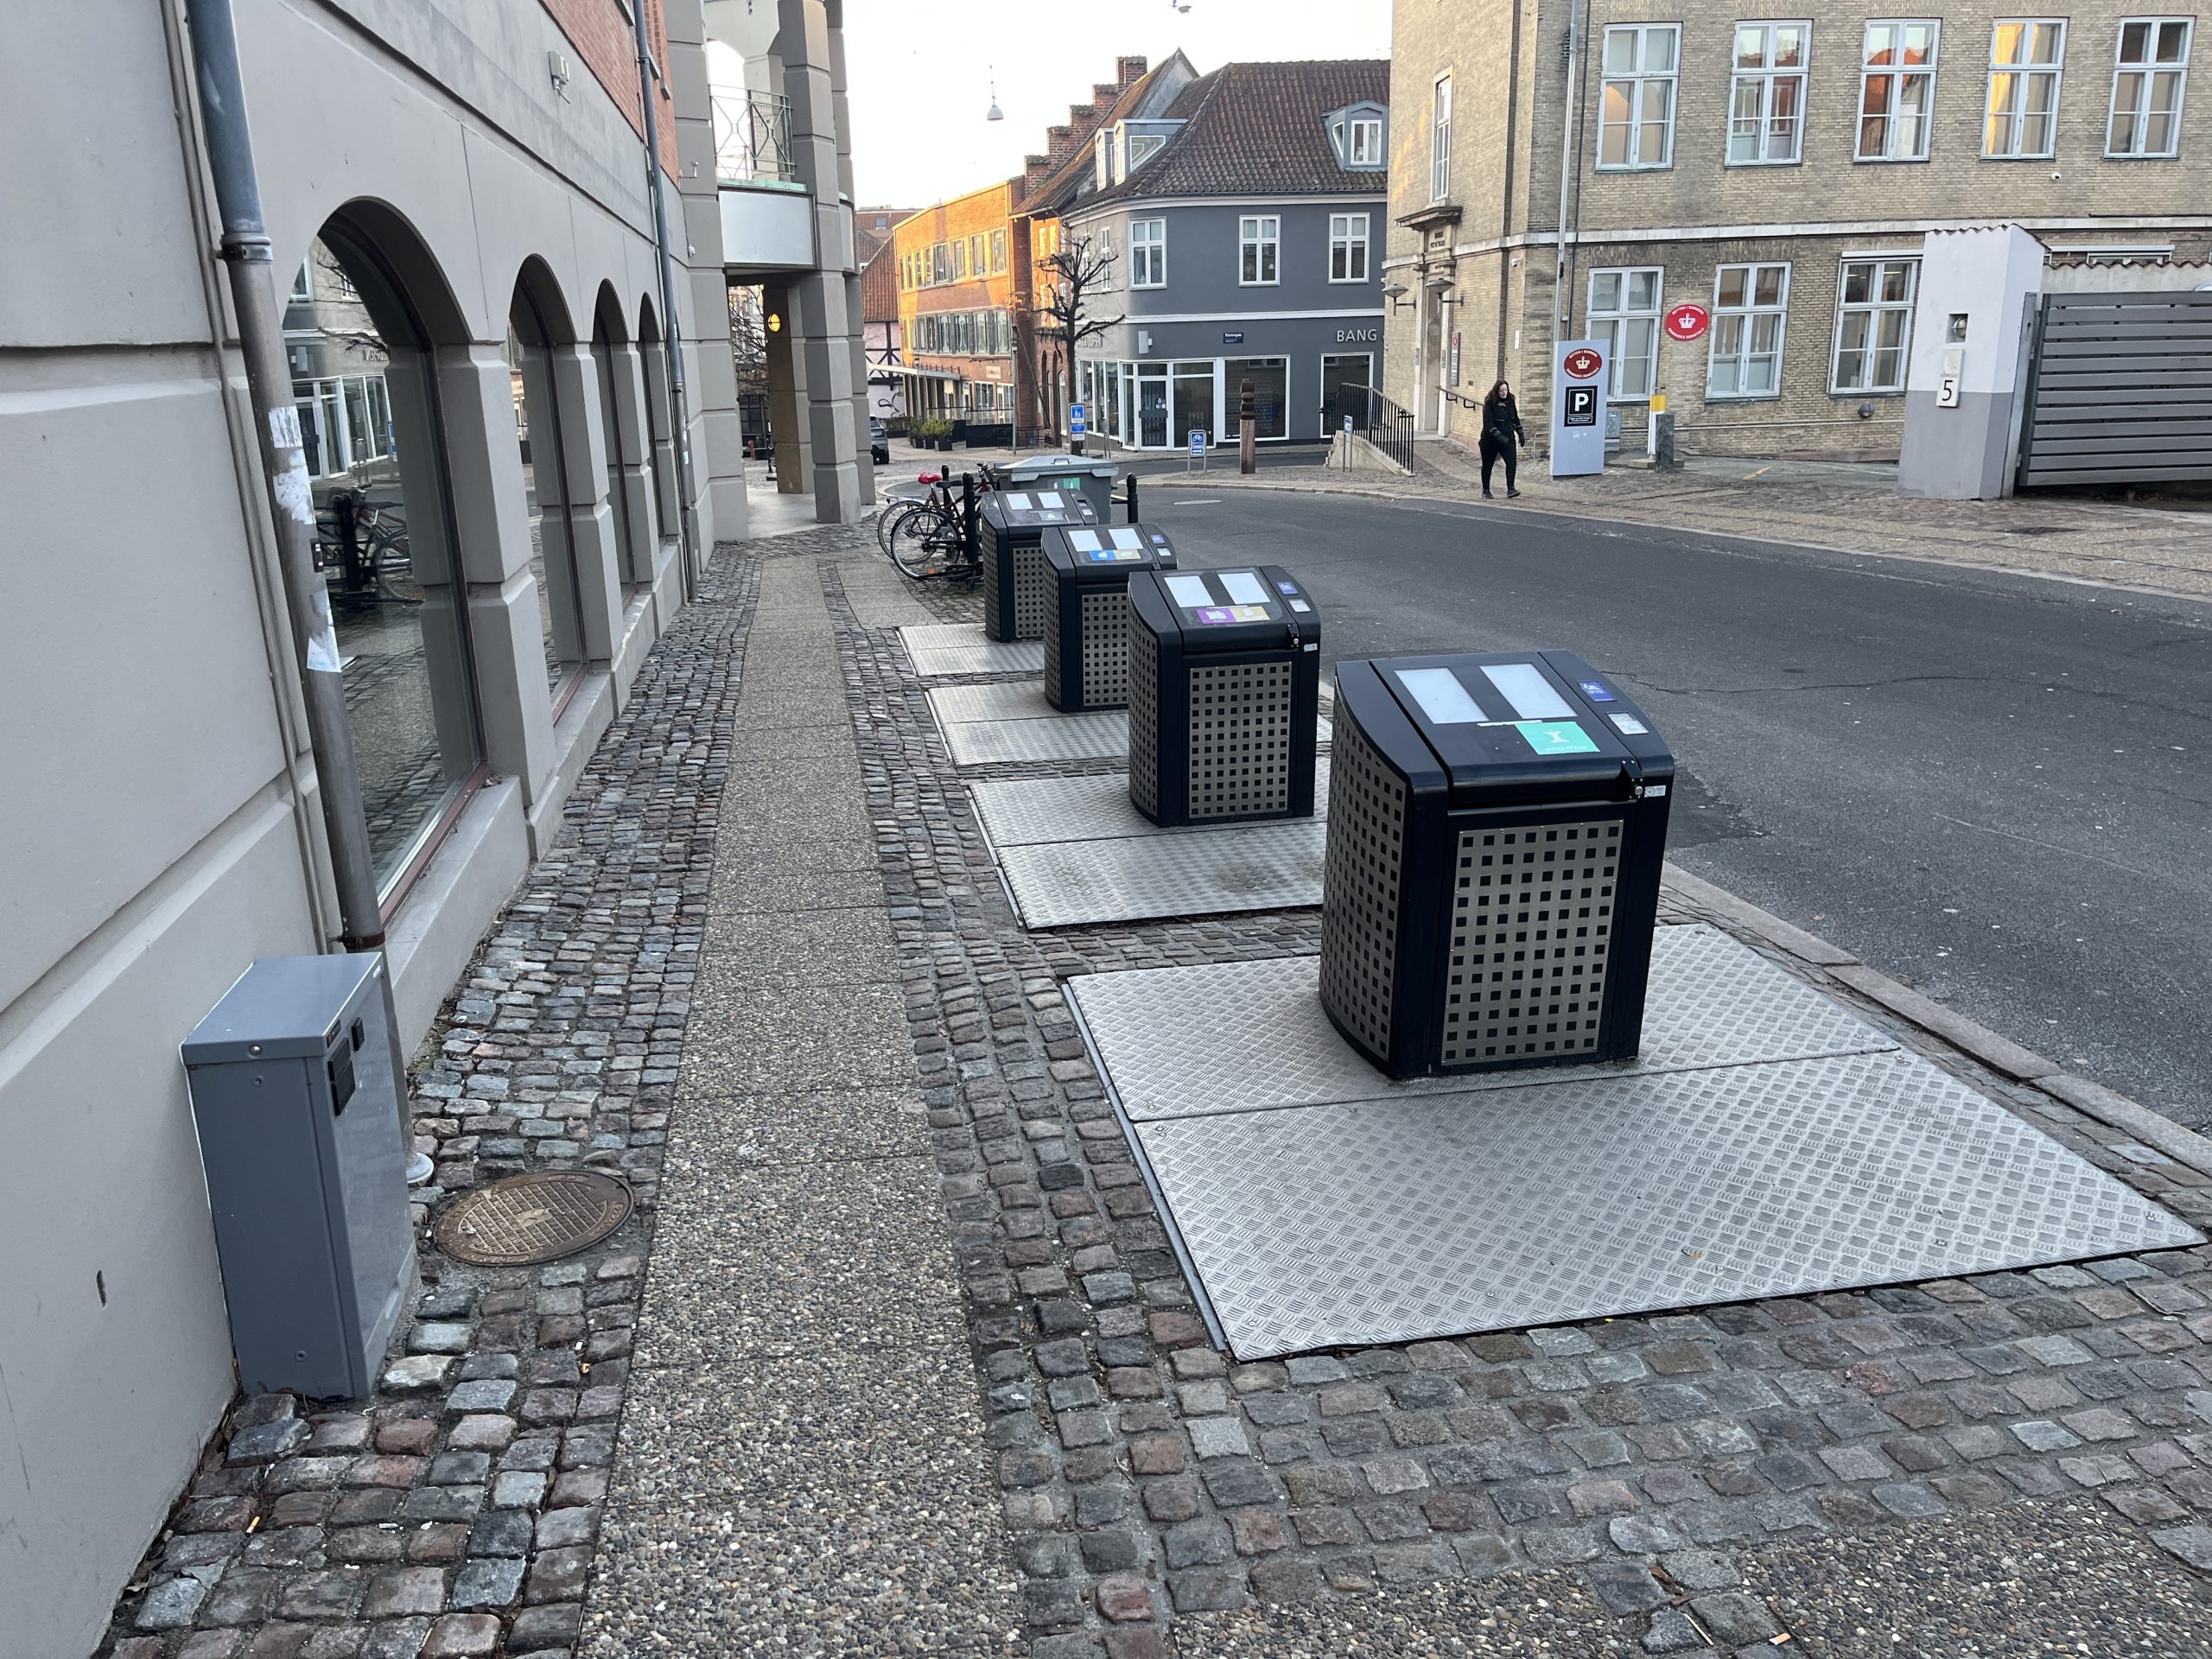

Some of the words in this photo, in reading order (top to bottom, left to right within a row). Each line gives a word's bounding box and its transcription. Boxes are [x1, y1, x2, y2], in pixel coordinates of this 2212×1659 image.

[1337, 329, 1377, 342] BANG
[1942, 380, 1954, 401] 5
[1574, 393, 1589, 411] P
